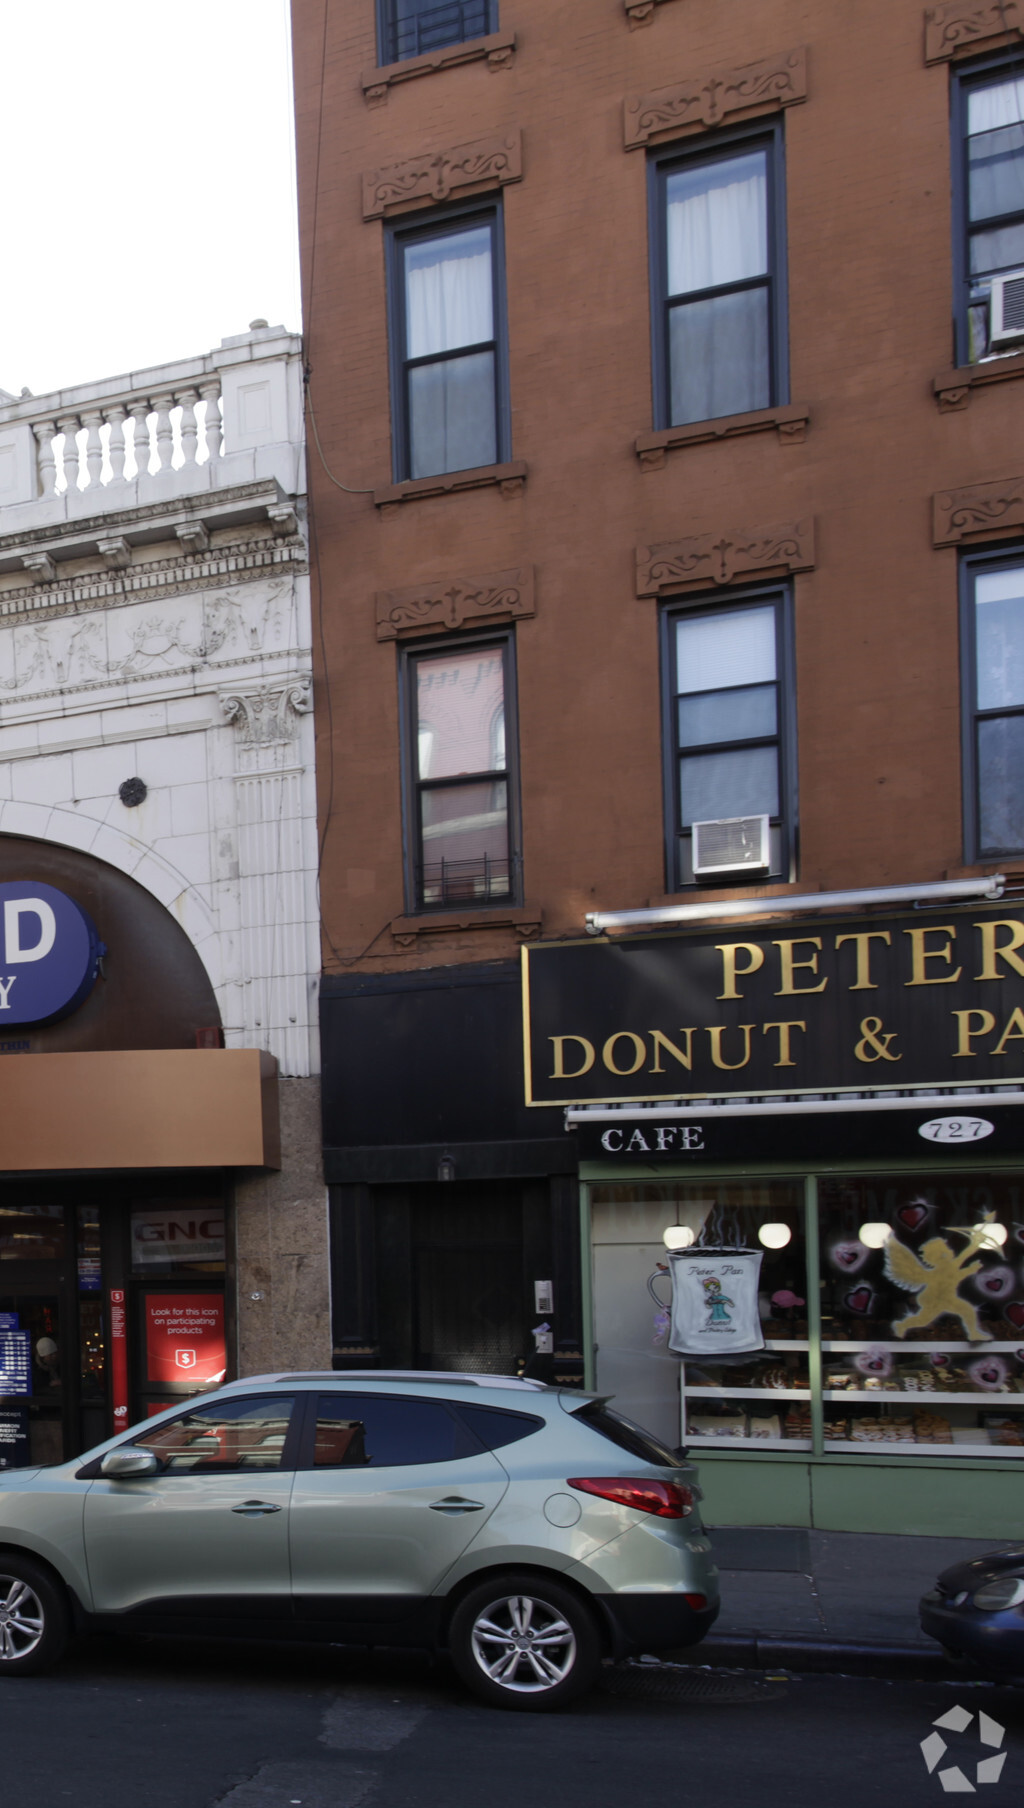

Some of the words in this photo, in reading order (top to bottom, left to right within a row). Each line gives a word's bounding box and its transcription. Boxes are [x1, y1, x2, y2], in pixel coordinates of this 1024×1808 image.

[714, 919, 1024, 1001] PETER
[548, 1020, 807, 1079] DONUT
[853, 1016, 903, 1064] &
[600, 1126, 705, 1152] CAFE
[928, 1121, 983, 1139] 727
[135, 1220, 225, 1242] GNC
[687, 1266, 716, 1276] Peter
[720, 1265, 744, 1276] Pan
[151, 1308, 171, 1316] Look
[172, 1308, 184, 1316] for
[186, 1308, 200, 1316] this
[201, 1308, 219, 1316] icon
[166, 1318, 216, 1326] participating
[167, 1327, 203, 1336] products
